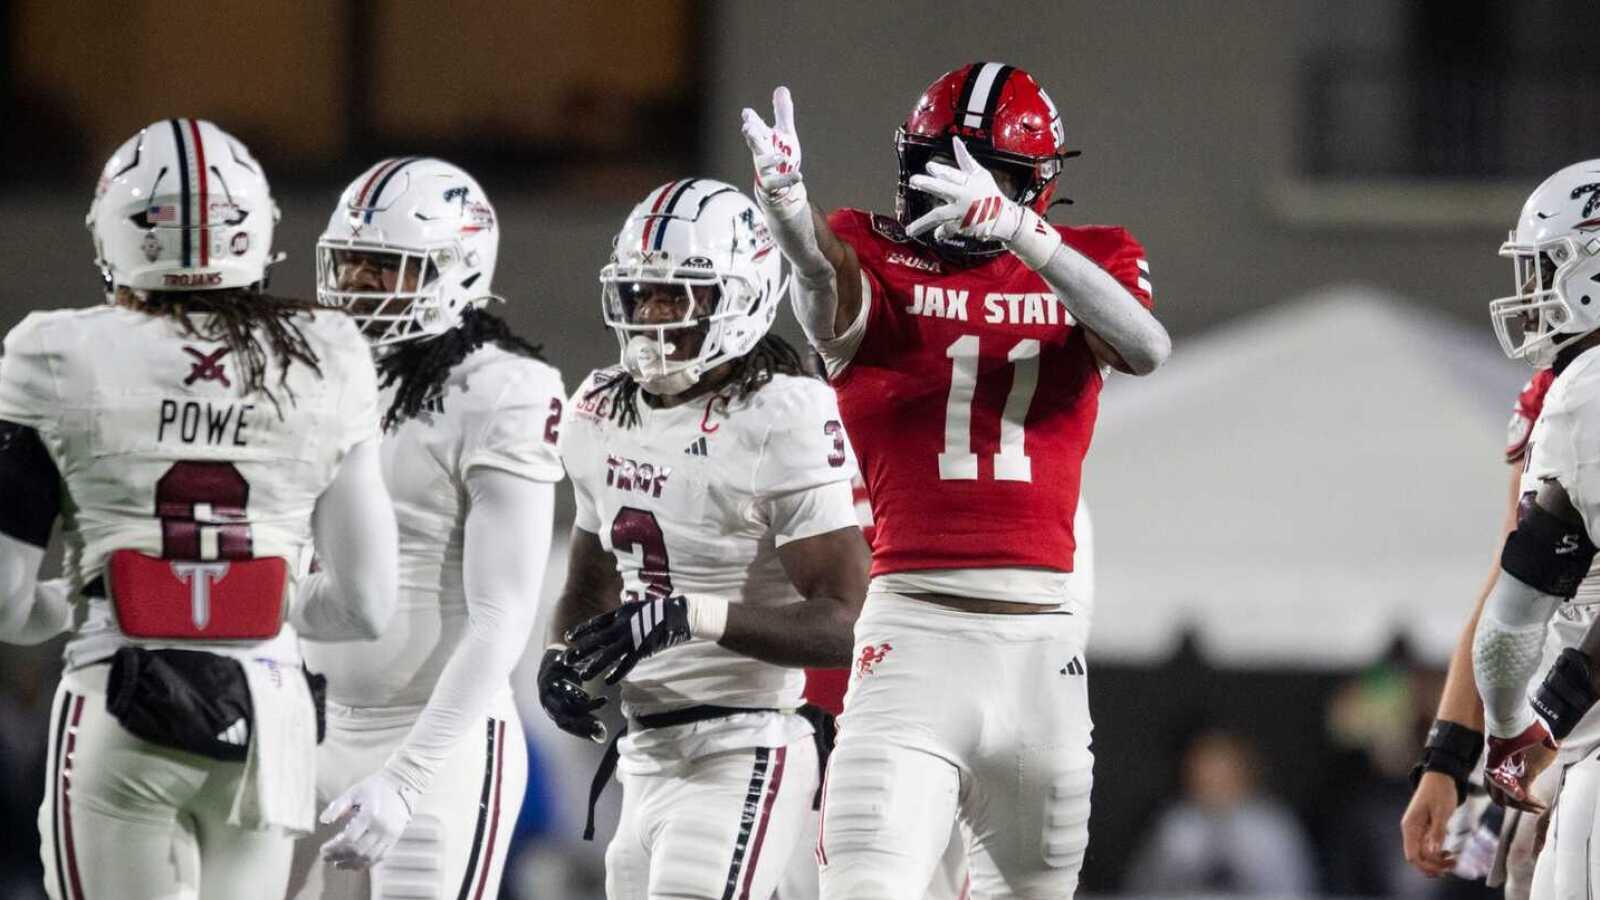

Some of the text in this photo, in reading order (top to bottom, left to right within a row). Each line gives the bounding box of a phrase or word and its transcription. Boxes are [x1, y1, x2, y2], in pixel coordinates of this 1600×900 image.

[163, 272, 222, 287] TROJANS
[905, 284, 969, 321] JAX
[158, 399, 254, 447] POWE
[543, 397, 563, 446] 2
[938, 334, 1041, 482] 11
[823, 420, 846, 468] 3
[606, 454, 672, 498] TROY
[610, 506, 674, 602] 3
